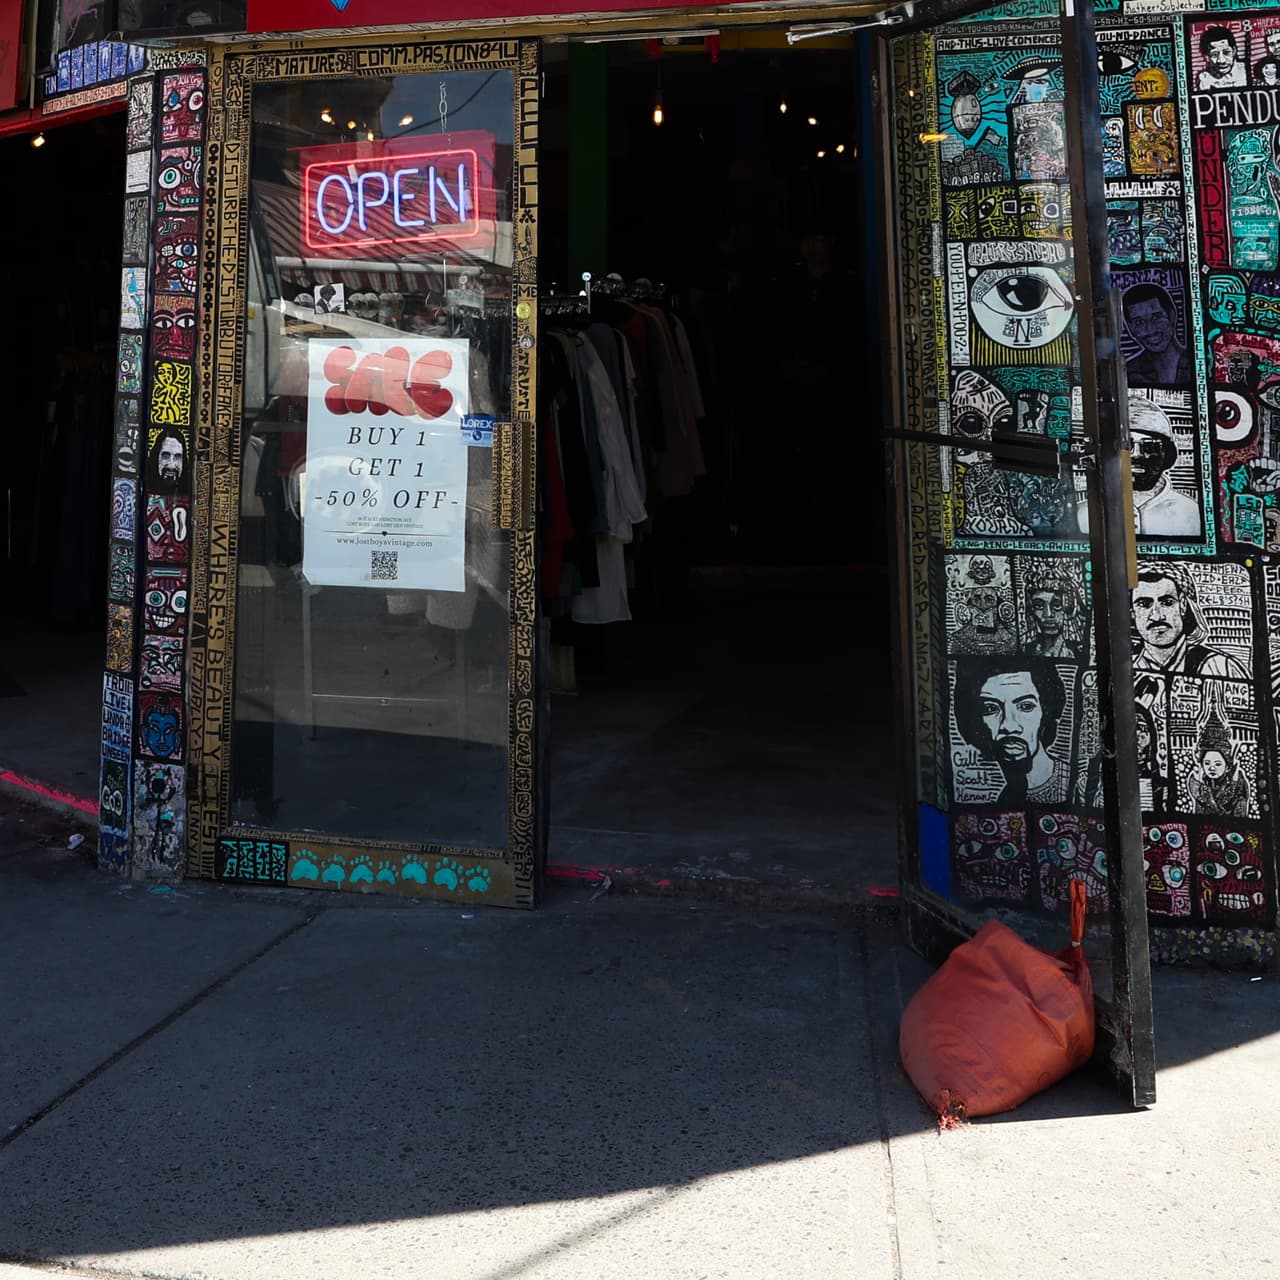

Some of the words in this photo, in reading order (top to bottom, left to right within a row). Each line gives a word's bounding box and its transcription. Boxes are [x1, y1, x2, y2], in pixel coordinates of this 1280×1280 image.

[274, 53, 335, 76] MATURE
[222, 142, 241, 220] DISTURB
[316, 162, 468, 235] OPEN
[221, 223, 239, 258] THE
[347, 427, 405, 446] BUY
[416, 431, 425, 446] 1
[461, 419, 493, 430] LOREX
[348, 458, 402, 477] GET
[414, 462, 424, 477] 1
[208, 523, 229, 640] WHERE'S
[204, 648, 226, 761] BEAUTY
[955, 770, 990, 786] Scott
